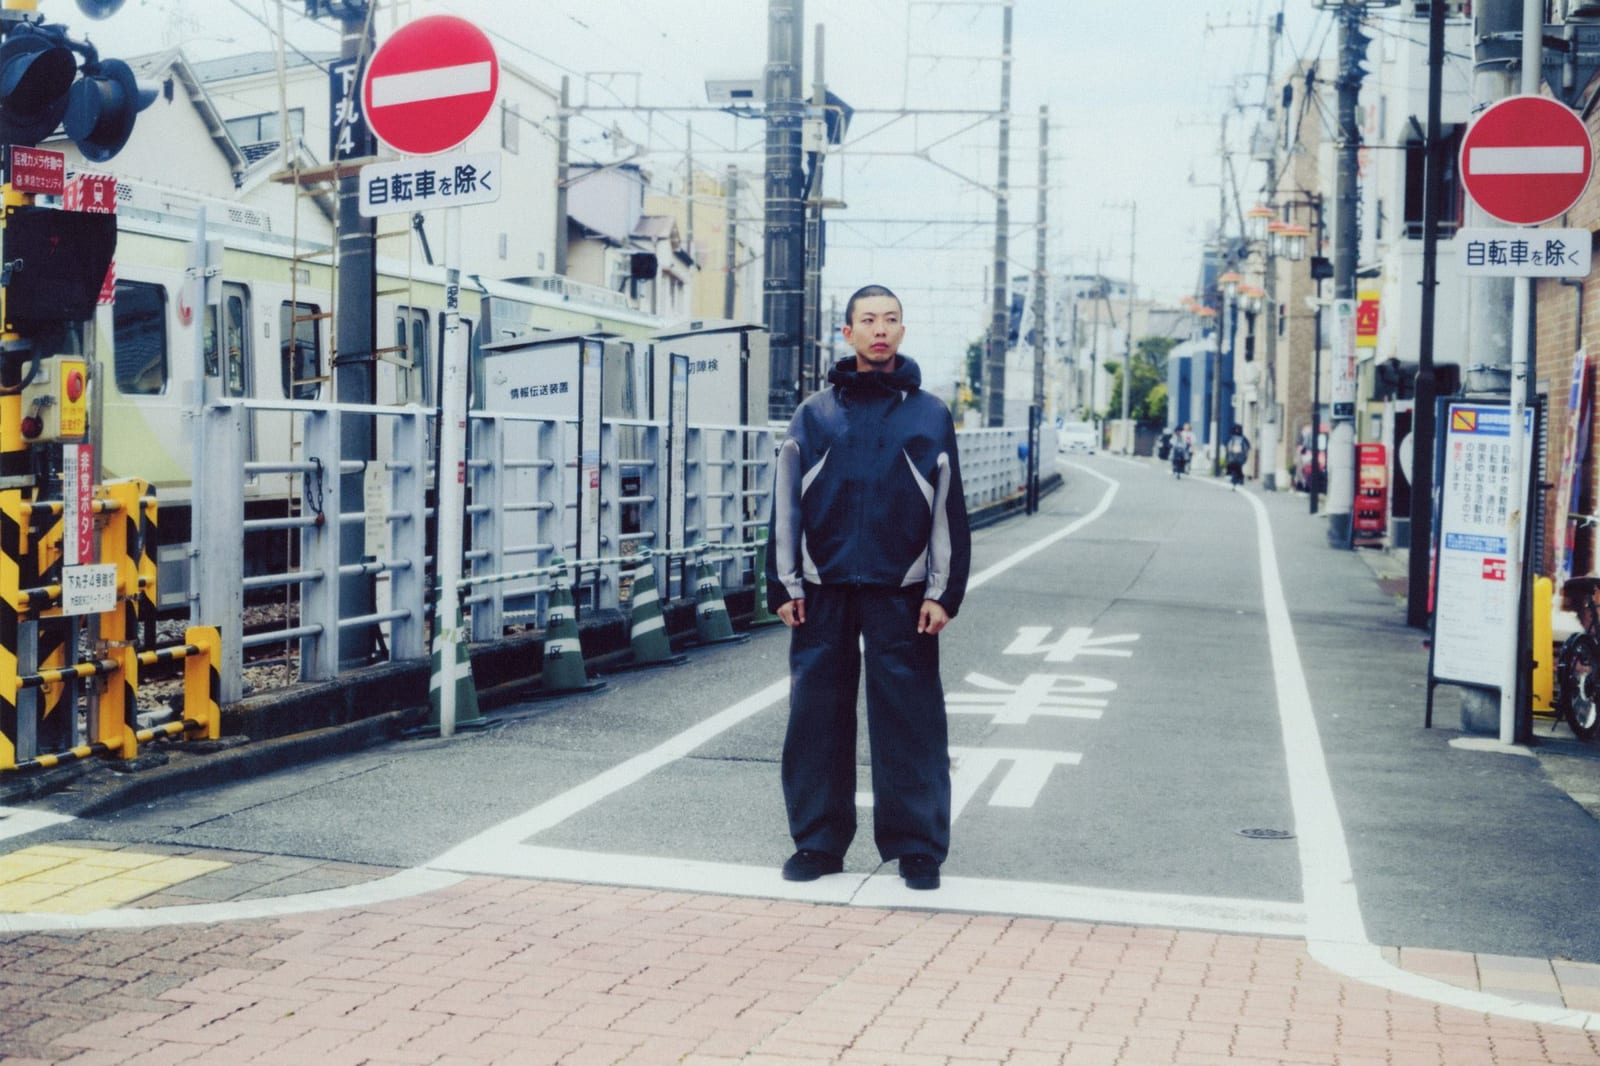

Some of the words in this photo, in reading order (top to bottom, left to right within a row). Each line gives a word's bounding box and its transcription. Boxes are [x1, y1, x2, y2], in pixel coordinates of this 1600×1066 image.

[14, 151, 63, 171] 監視カメラ作動中
[368, 164, 492, 205] 自転車を除く
[1467, 240, 1579, 266] 自転車を除く
[510, 381, 569, 400] 情報伝送装置
[80, 451, 91, 556] 非常ボタン
